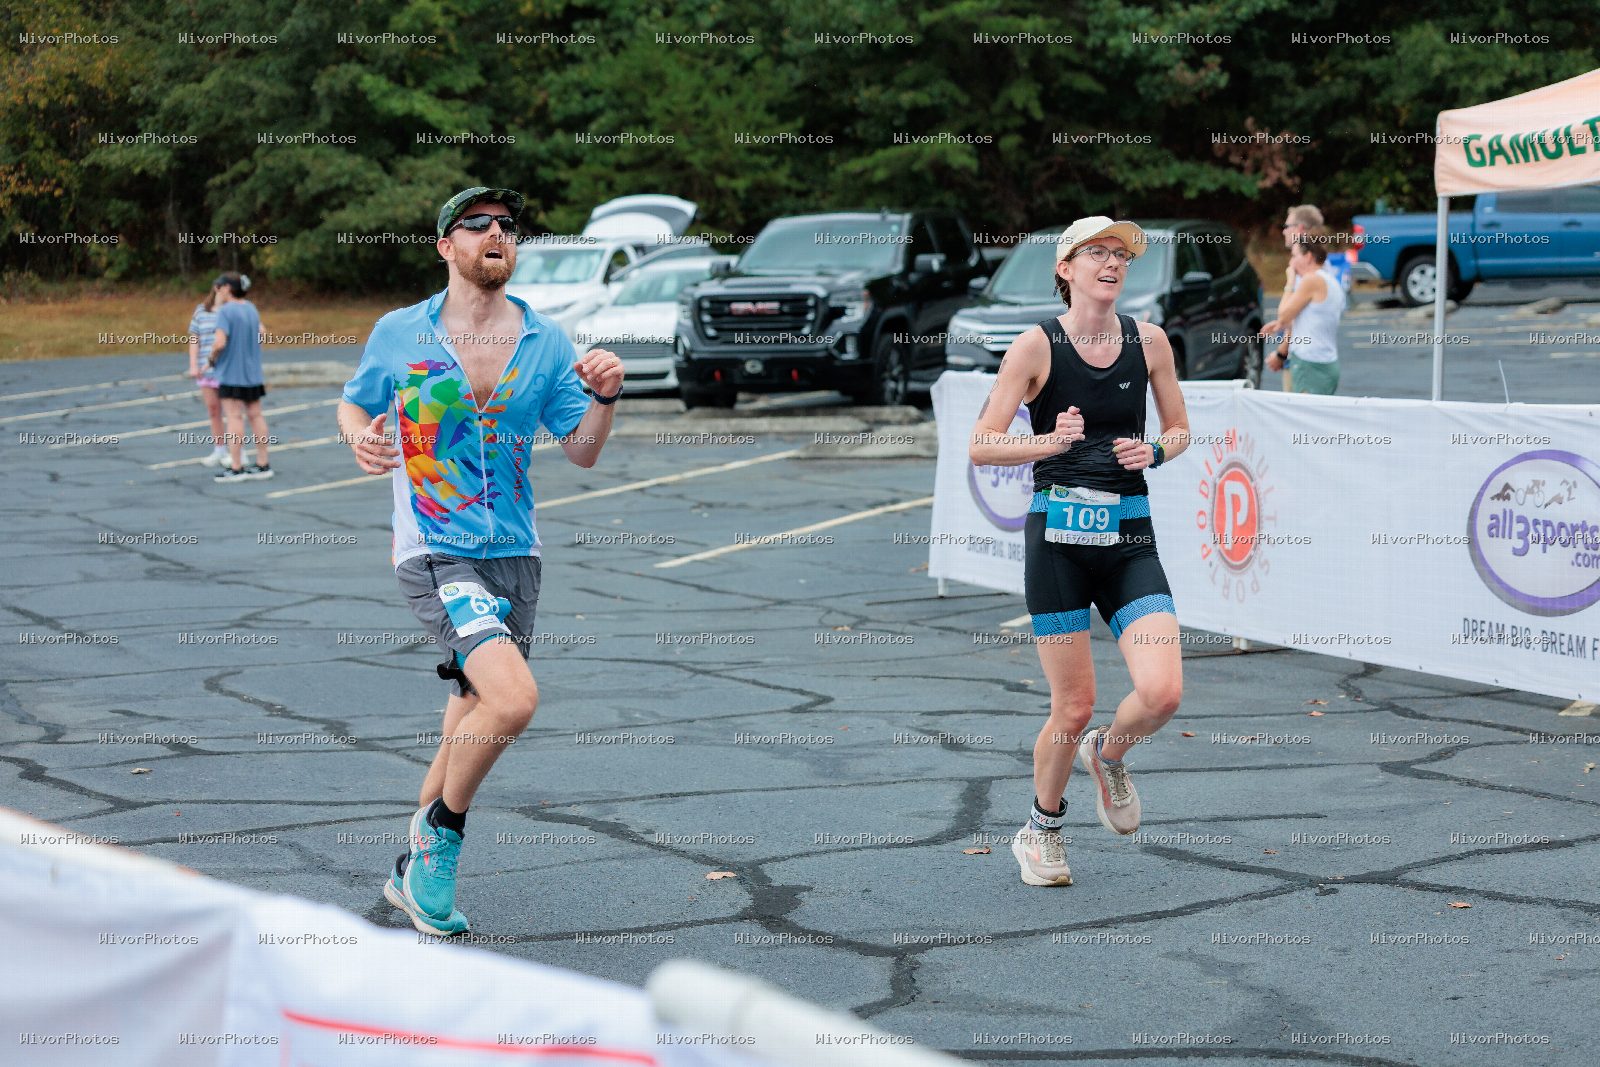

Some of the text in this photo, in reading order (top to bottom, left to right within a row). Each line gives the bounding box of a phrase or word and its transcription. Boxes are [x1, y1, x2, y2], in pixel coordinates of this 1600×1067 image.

[1062, 504, 1110, 531] 109
[1462, 618, 1506, 646] DREAM
[1510, 625, 1537, 652] BIG.
[1541, 629, 1588, 660] DREAM
